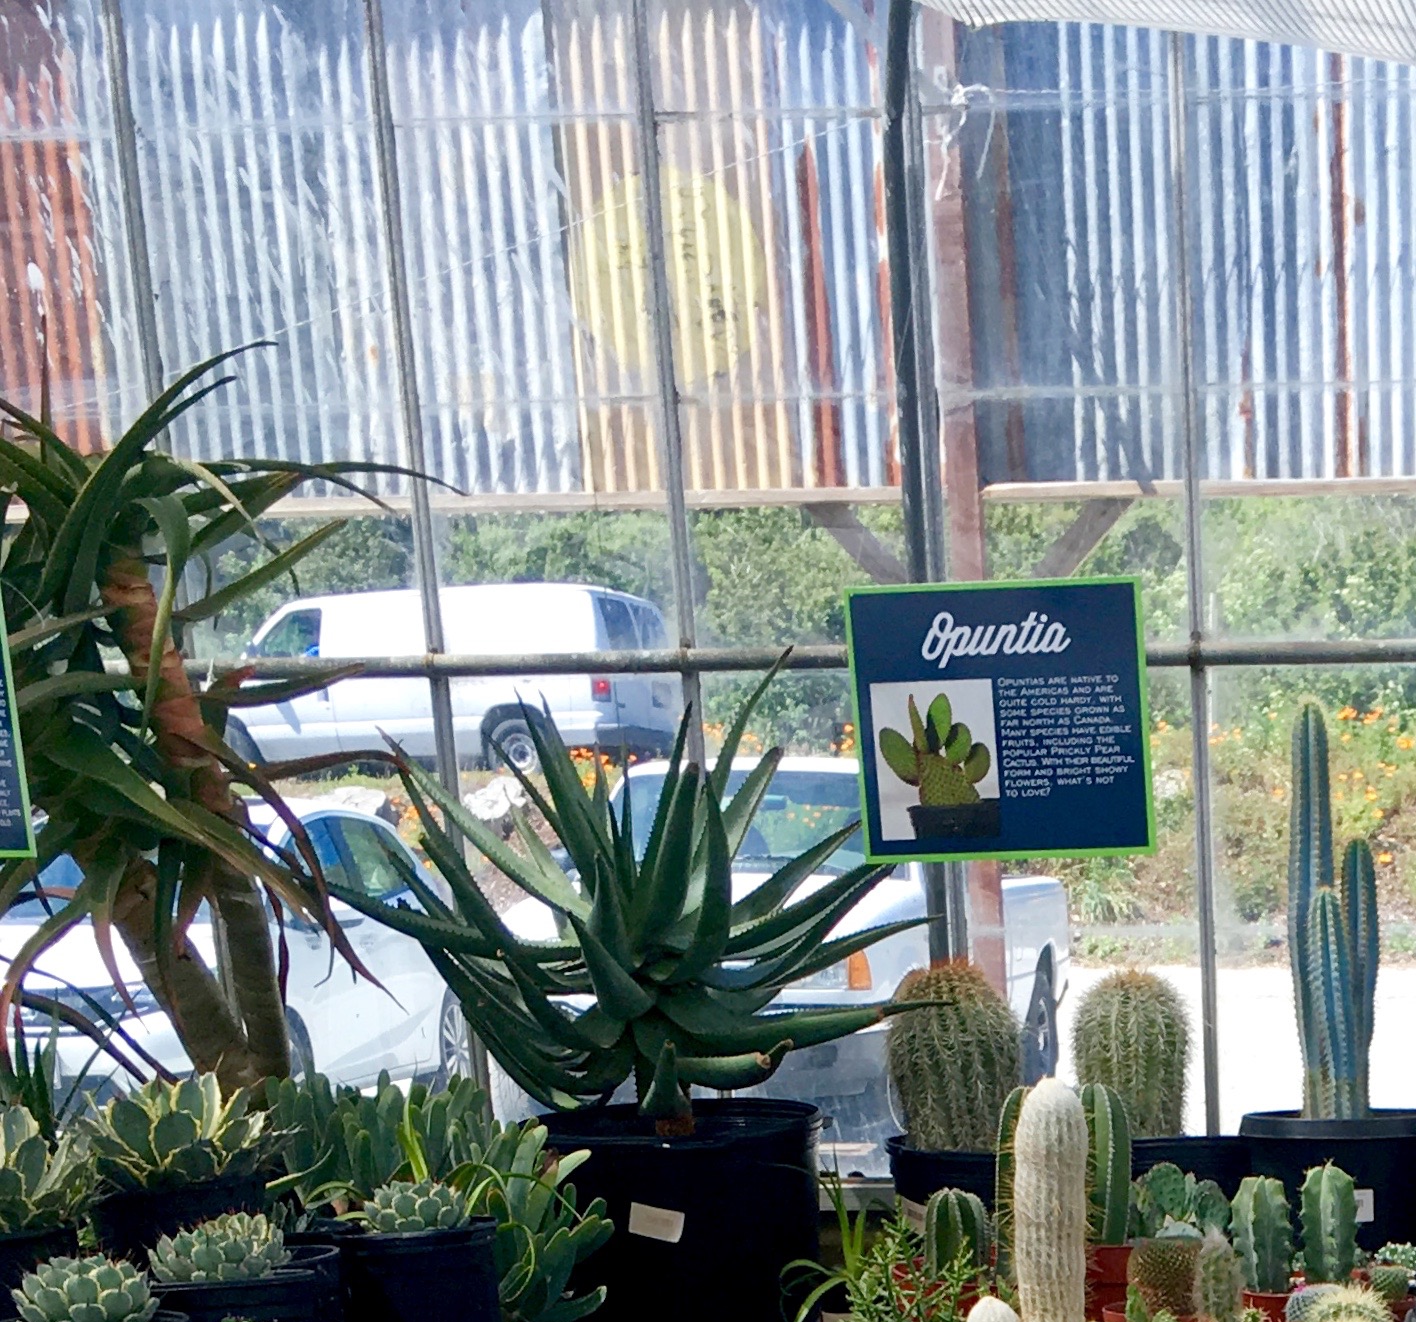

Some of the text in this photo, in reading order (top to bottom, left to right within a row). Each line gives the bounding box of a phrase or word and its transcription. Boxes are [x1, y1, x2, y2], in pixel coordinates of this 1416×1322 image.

[922, 611, 1071, 669] Opuntia
[998, 678, 1045, 686] OPUNTIAS
[1048, 677, 1067, 685] ARE
[999, 689, 1017, 697] THE
[1020, 687, 1069, 695] AMERICAS
[999, 699, 1027, 707] QUITE
[1031, 698, 1057, 706] COLD
[1100, 695, 1122, 703] WITH
[1031, 708, 1071, 716] SPECIES
[1075, 706, 1109, 714] GROWN
[1001, 719, 1019, 727] FAR
[1003, 749, 1047, 757] POPULAR
[1051, 747, 1091, 755] PRICKLY
[1004, 769, 1031, 777] FORM
[1006, 788, 1051, 798] TO LOVE?
